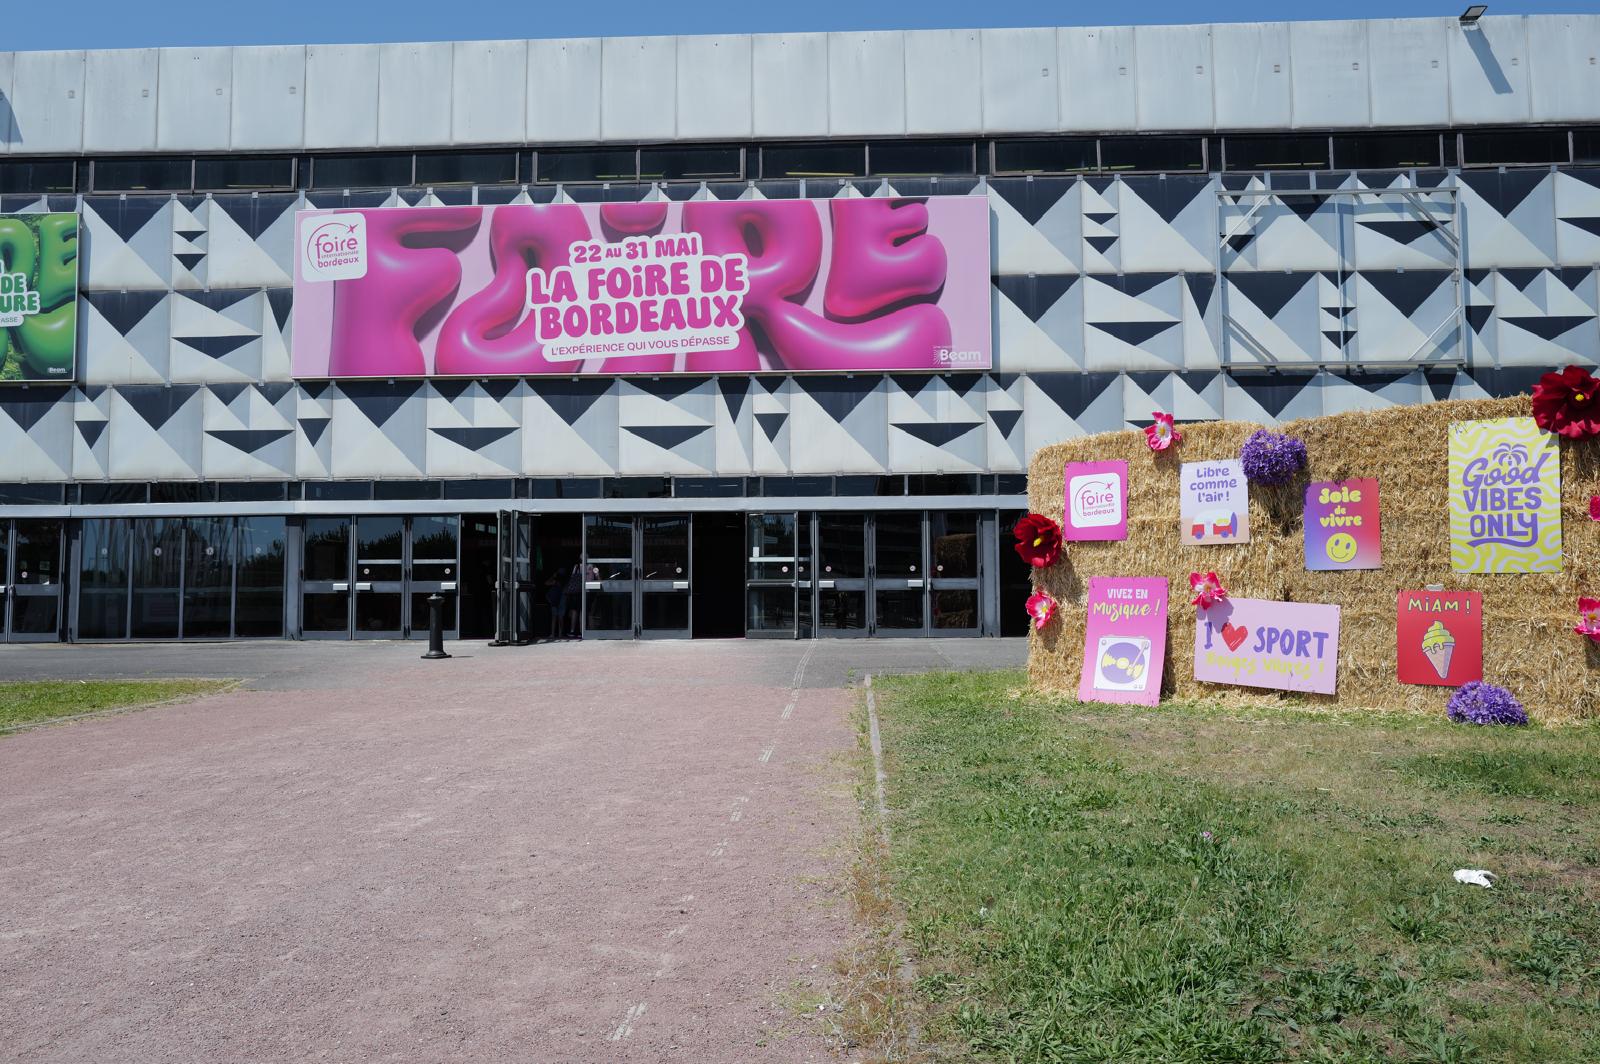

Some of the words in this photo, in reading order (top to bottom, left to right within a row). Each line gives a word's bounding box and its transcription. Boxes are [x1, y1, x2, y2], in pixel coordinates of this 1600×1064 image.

[315, 233, 358, 257] foire
[573, 244, 602, 263] 22
[605, 247, 622, 258] AU
[625, 241, 648, 260] 31
[655, 237, 698, 257] MAI
[317, 257, 359, 268] bordeaux
[1, 275, 25, 294] DE
[531, 270, 578, 305] LA
[700, 258, 745, 294] DE
[540, 294, 740, 340] BORDEAUX
[551, 342, 625, 356] L'EXPÉRIENCE
[627, 340, 647, 352] QUI
[648, 339, 679, 350] VOUS
[681, 335, 730, 348] DÉPASSE
[940, 349, 981, 361] Beam
[1196, 467, 1230, 478] Libre
[1463, 453, 1552, 492] Good
[1190, 478, 1237, 491] comme
[1081, 490, 1114, 509] foire
[1198, 491, 1223, 503] l'air
[1463, 487, 1542, 512] VIBES
[1083, 509, 1115, 517] bordeaux
[1334, 505, 1346, 515] de
[1320, 514, 1362, 527] vivre
[1107, 588, 1133, 599] VIVEZ
[1135, 588, 1148, 599] EN
[1093, 601, 1152, 622] Musique
[1466, 600, 1470, 614] !
[1204, 621, 1213, 649] I
[1253, 626, 1329, 659] SPORT
